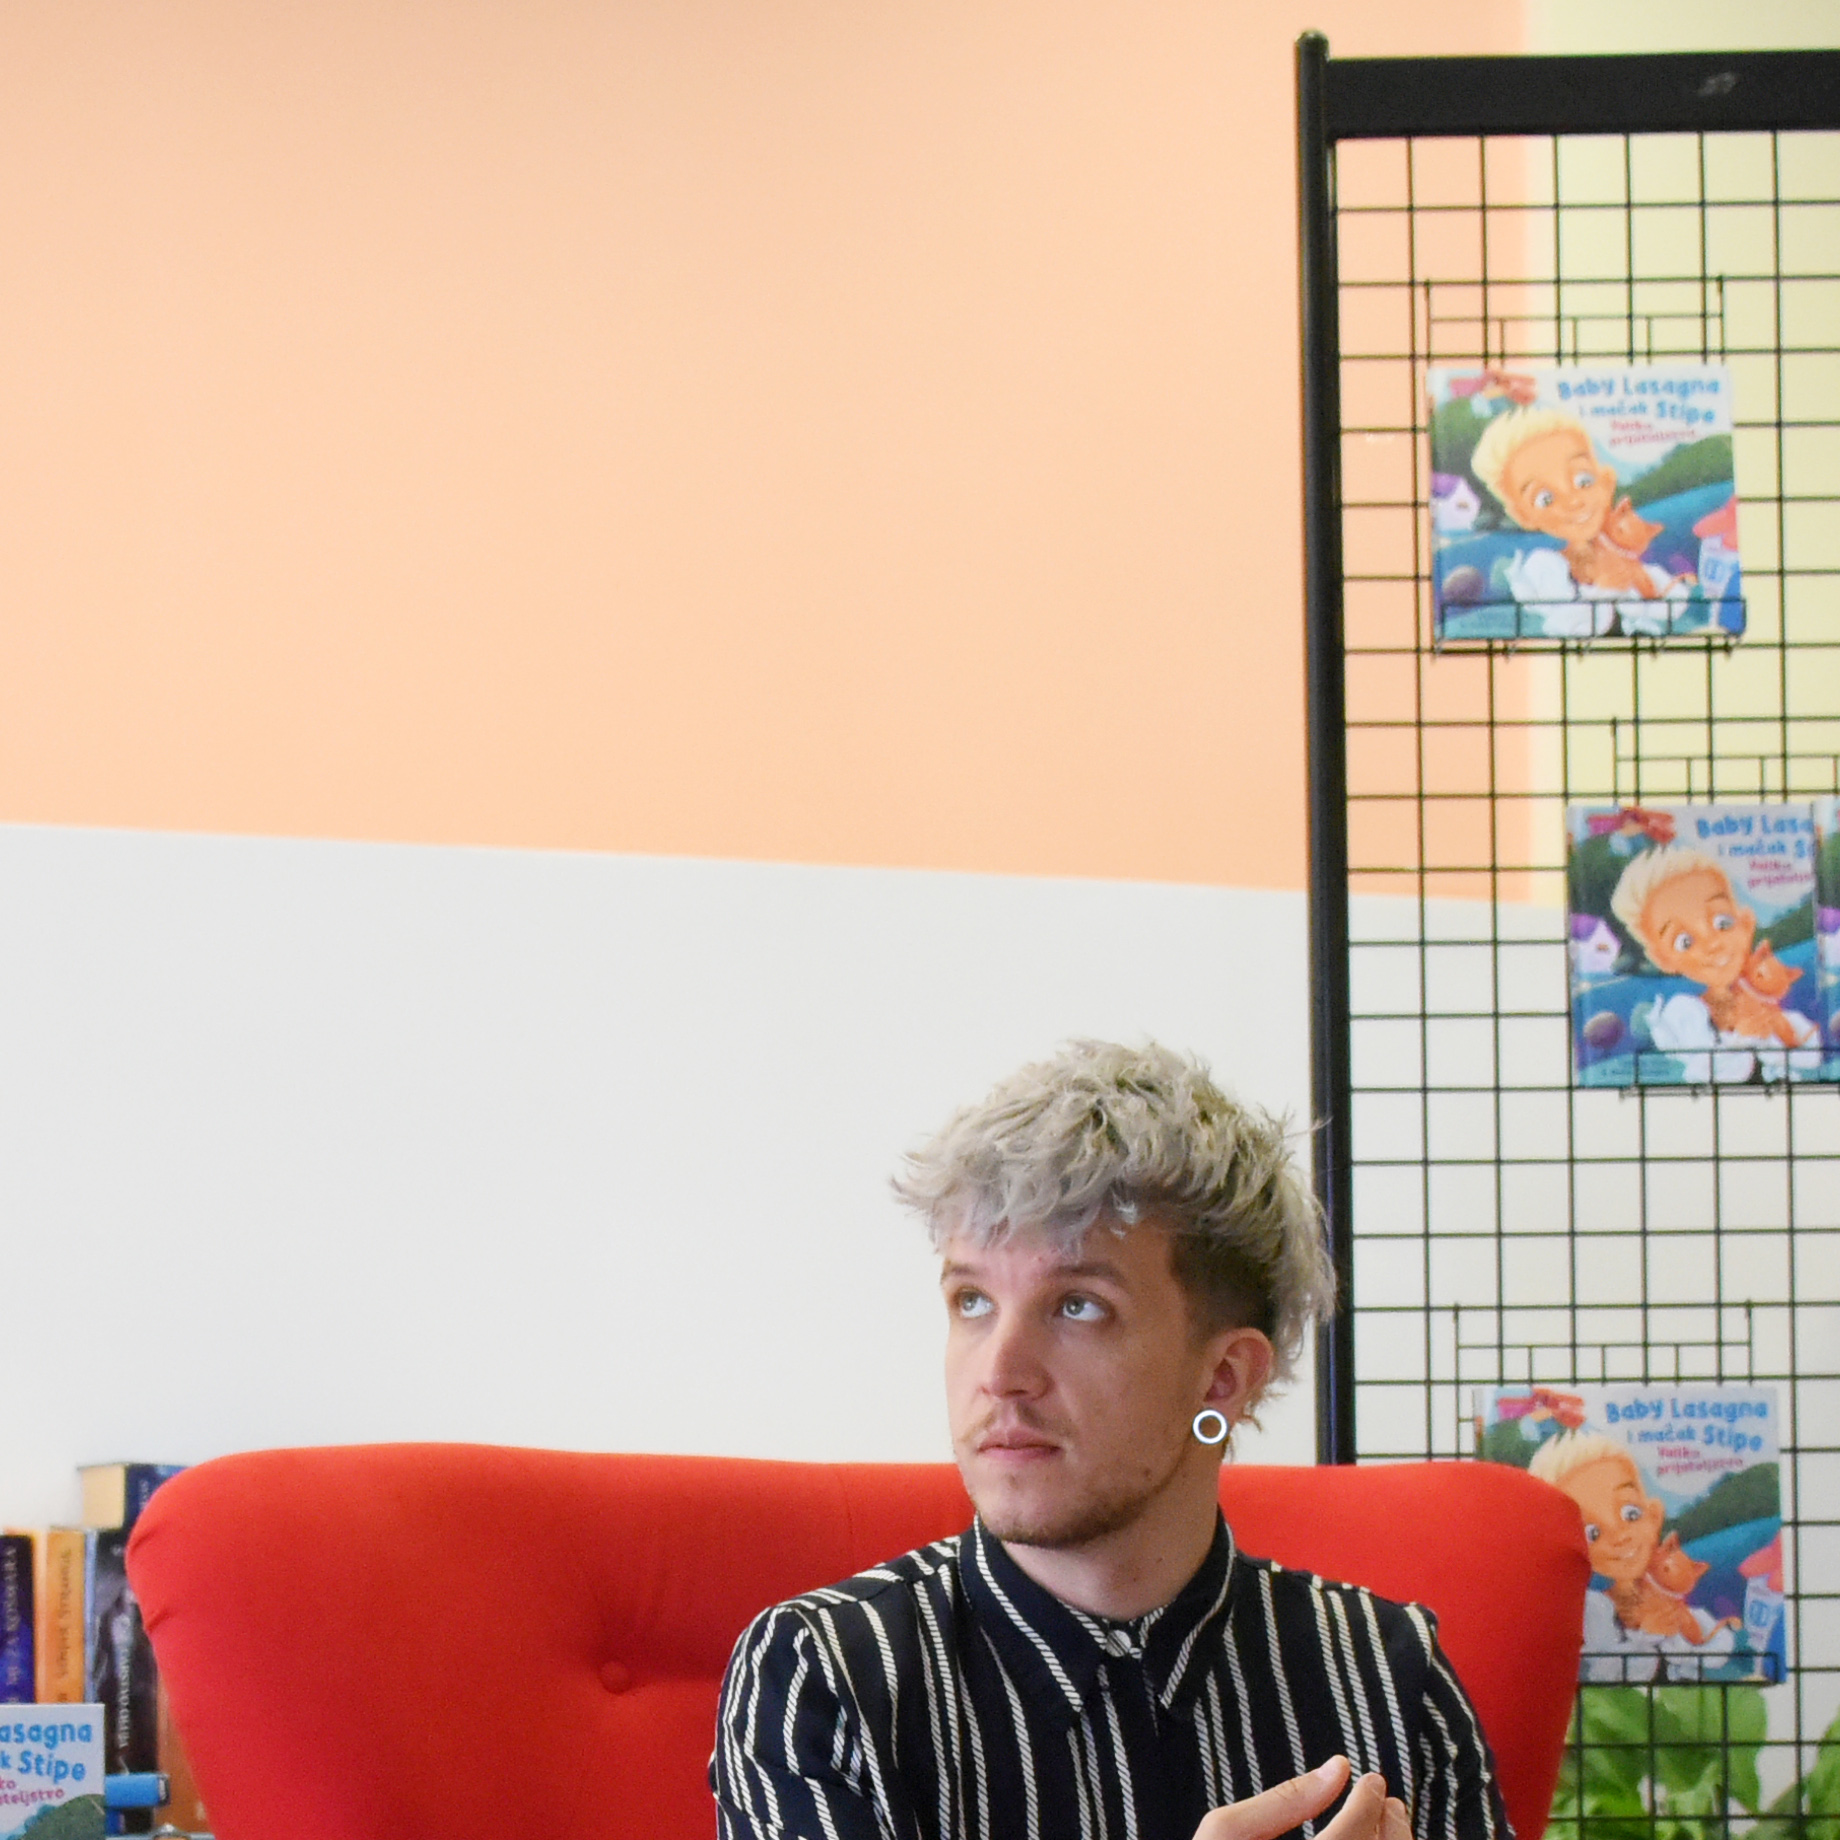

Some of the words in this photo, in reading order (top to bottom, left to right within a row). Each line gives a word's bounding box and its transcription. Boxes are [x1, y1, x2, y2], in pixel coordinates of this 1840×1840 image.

[1557, 378, 1615, 400] Baby
[1623, 377, 1720, 399] Lasagna
[1657, 400, 1715, 425] Stipe
[1697, 815, 1753, 838] Baby
[1606, 1398, 1664, 1423] Baby
[1671, 1398, 1768, 1422] Lasagna
[1704, 1424, 1762, 1452] Stipe
[118, 1647, 131, 1706] CARSTVO
[18, 1750, 87, 1785] Stipe
